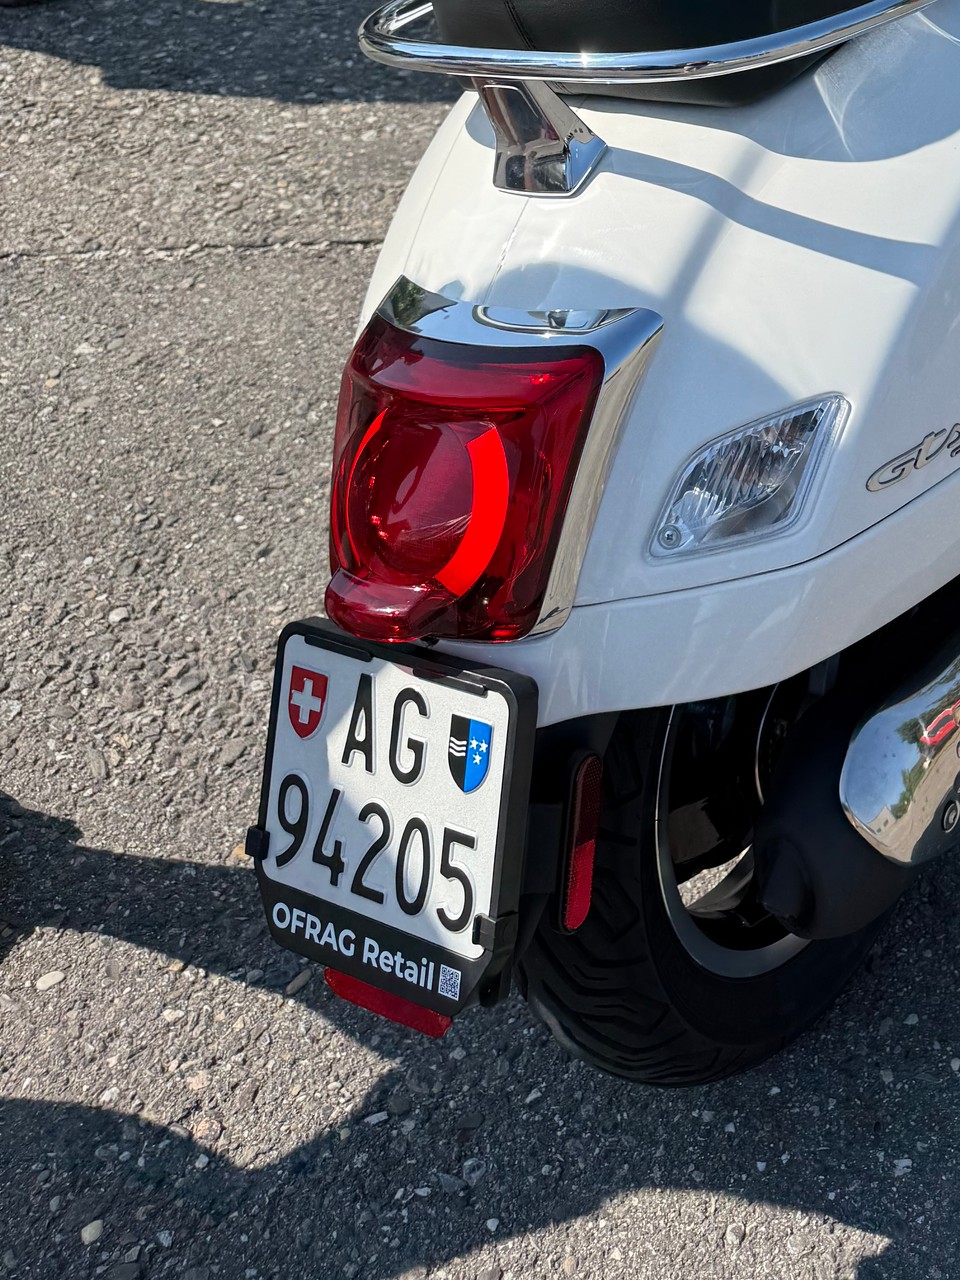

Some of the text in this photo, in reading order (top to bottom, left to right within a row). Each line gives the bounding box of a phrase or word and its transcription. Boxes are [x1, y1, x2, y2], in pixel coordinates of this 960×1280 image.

[341, 672, 430, 785] AG
[275, 773, 478, 933] 94205
[271, 901, 434, 991] OFRAG Retail
